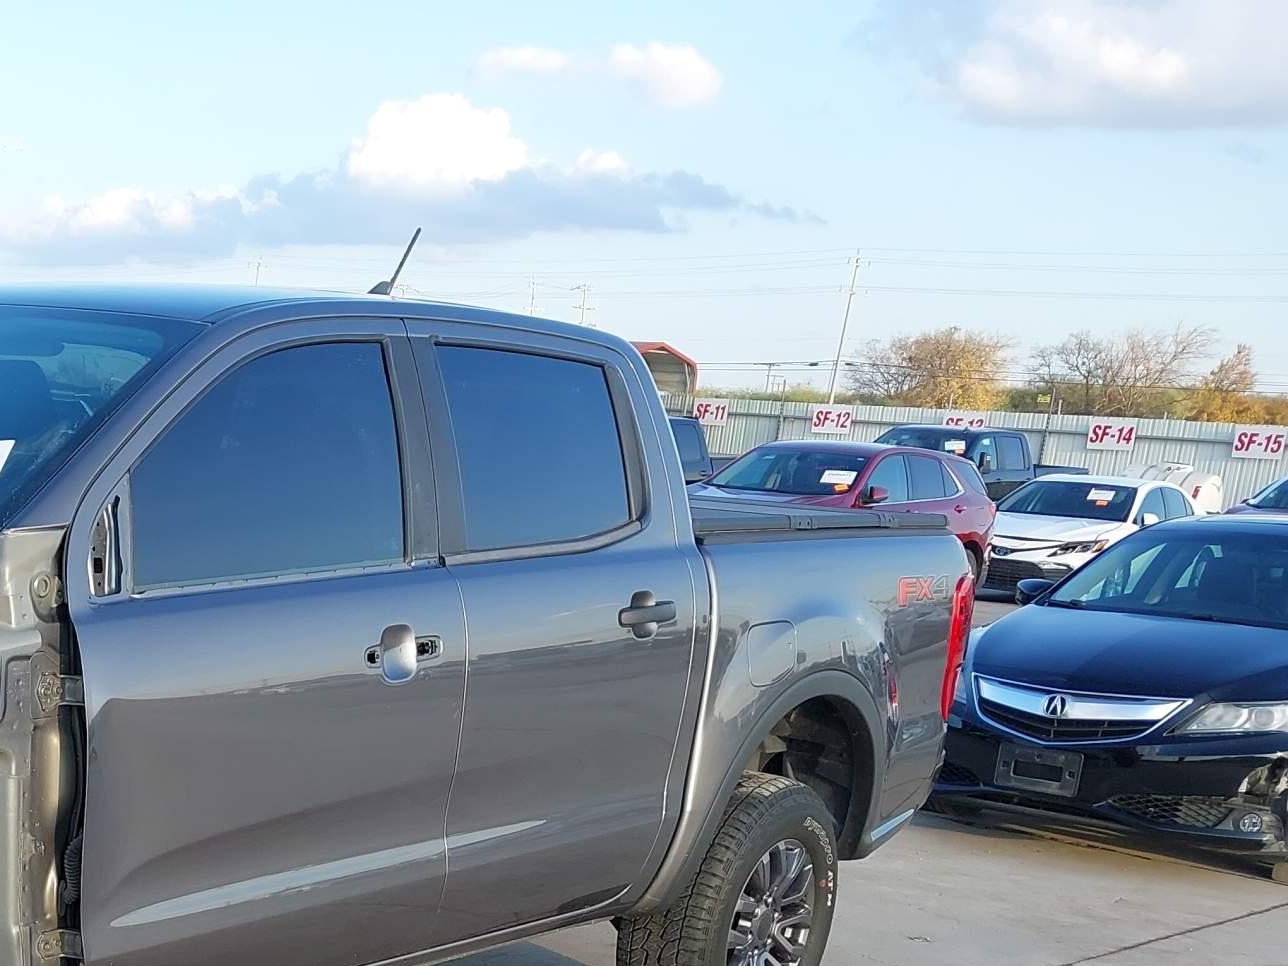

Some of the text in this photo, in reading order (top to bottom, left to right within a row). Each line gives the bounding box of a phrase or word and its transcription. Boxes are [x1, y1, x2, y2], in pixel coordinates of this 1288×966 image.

[695, 403, 727, 420] SF-11
[813, 410, 851, 429] SF-12
[945, 417, 984, 428] SF13
[1089, 424, 1135, 444] SF-14
[1234, 431, 1285, 453] SF-15
[898, 575, 951, 608] FX4
[803, 816, 833, 865] Dynapro
